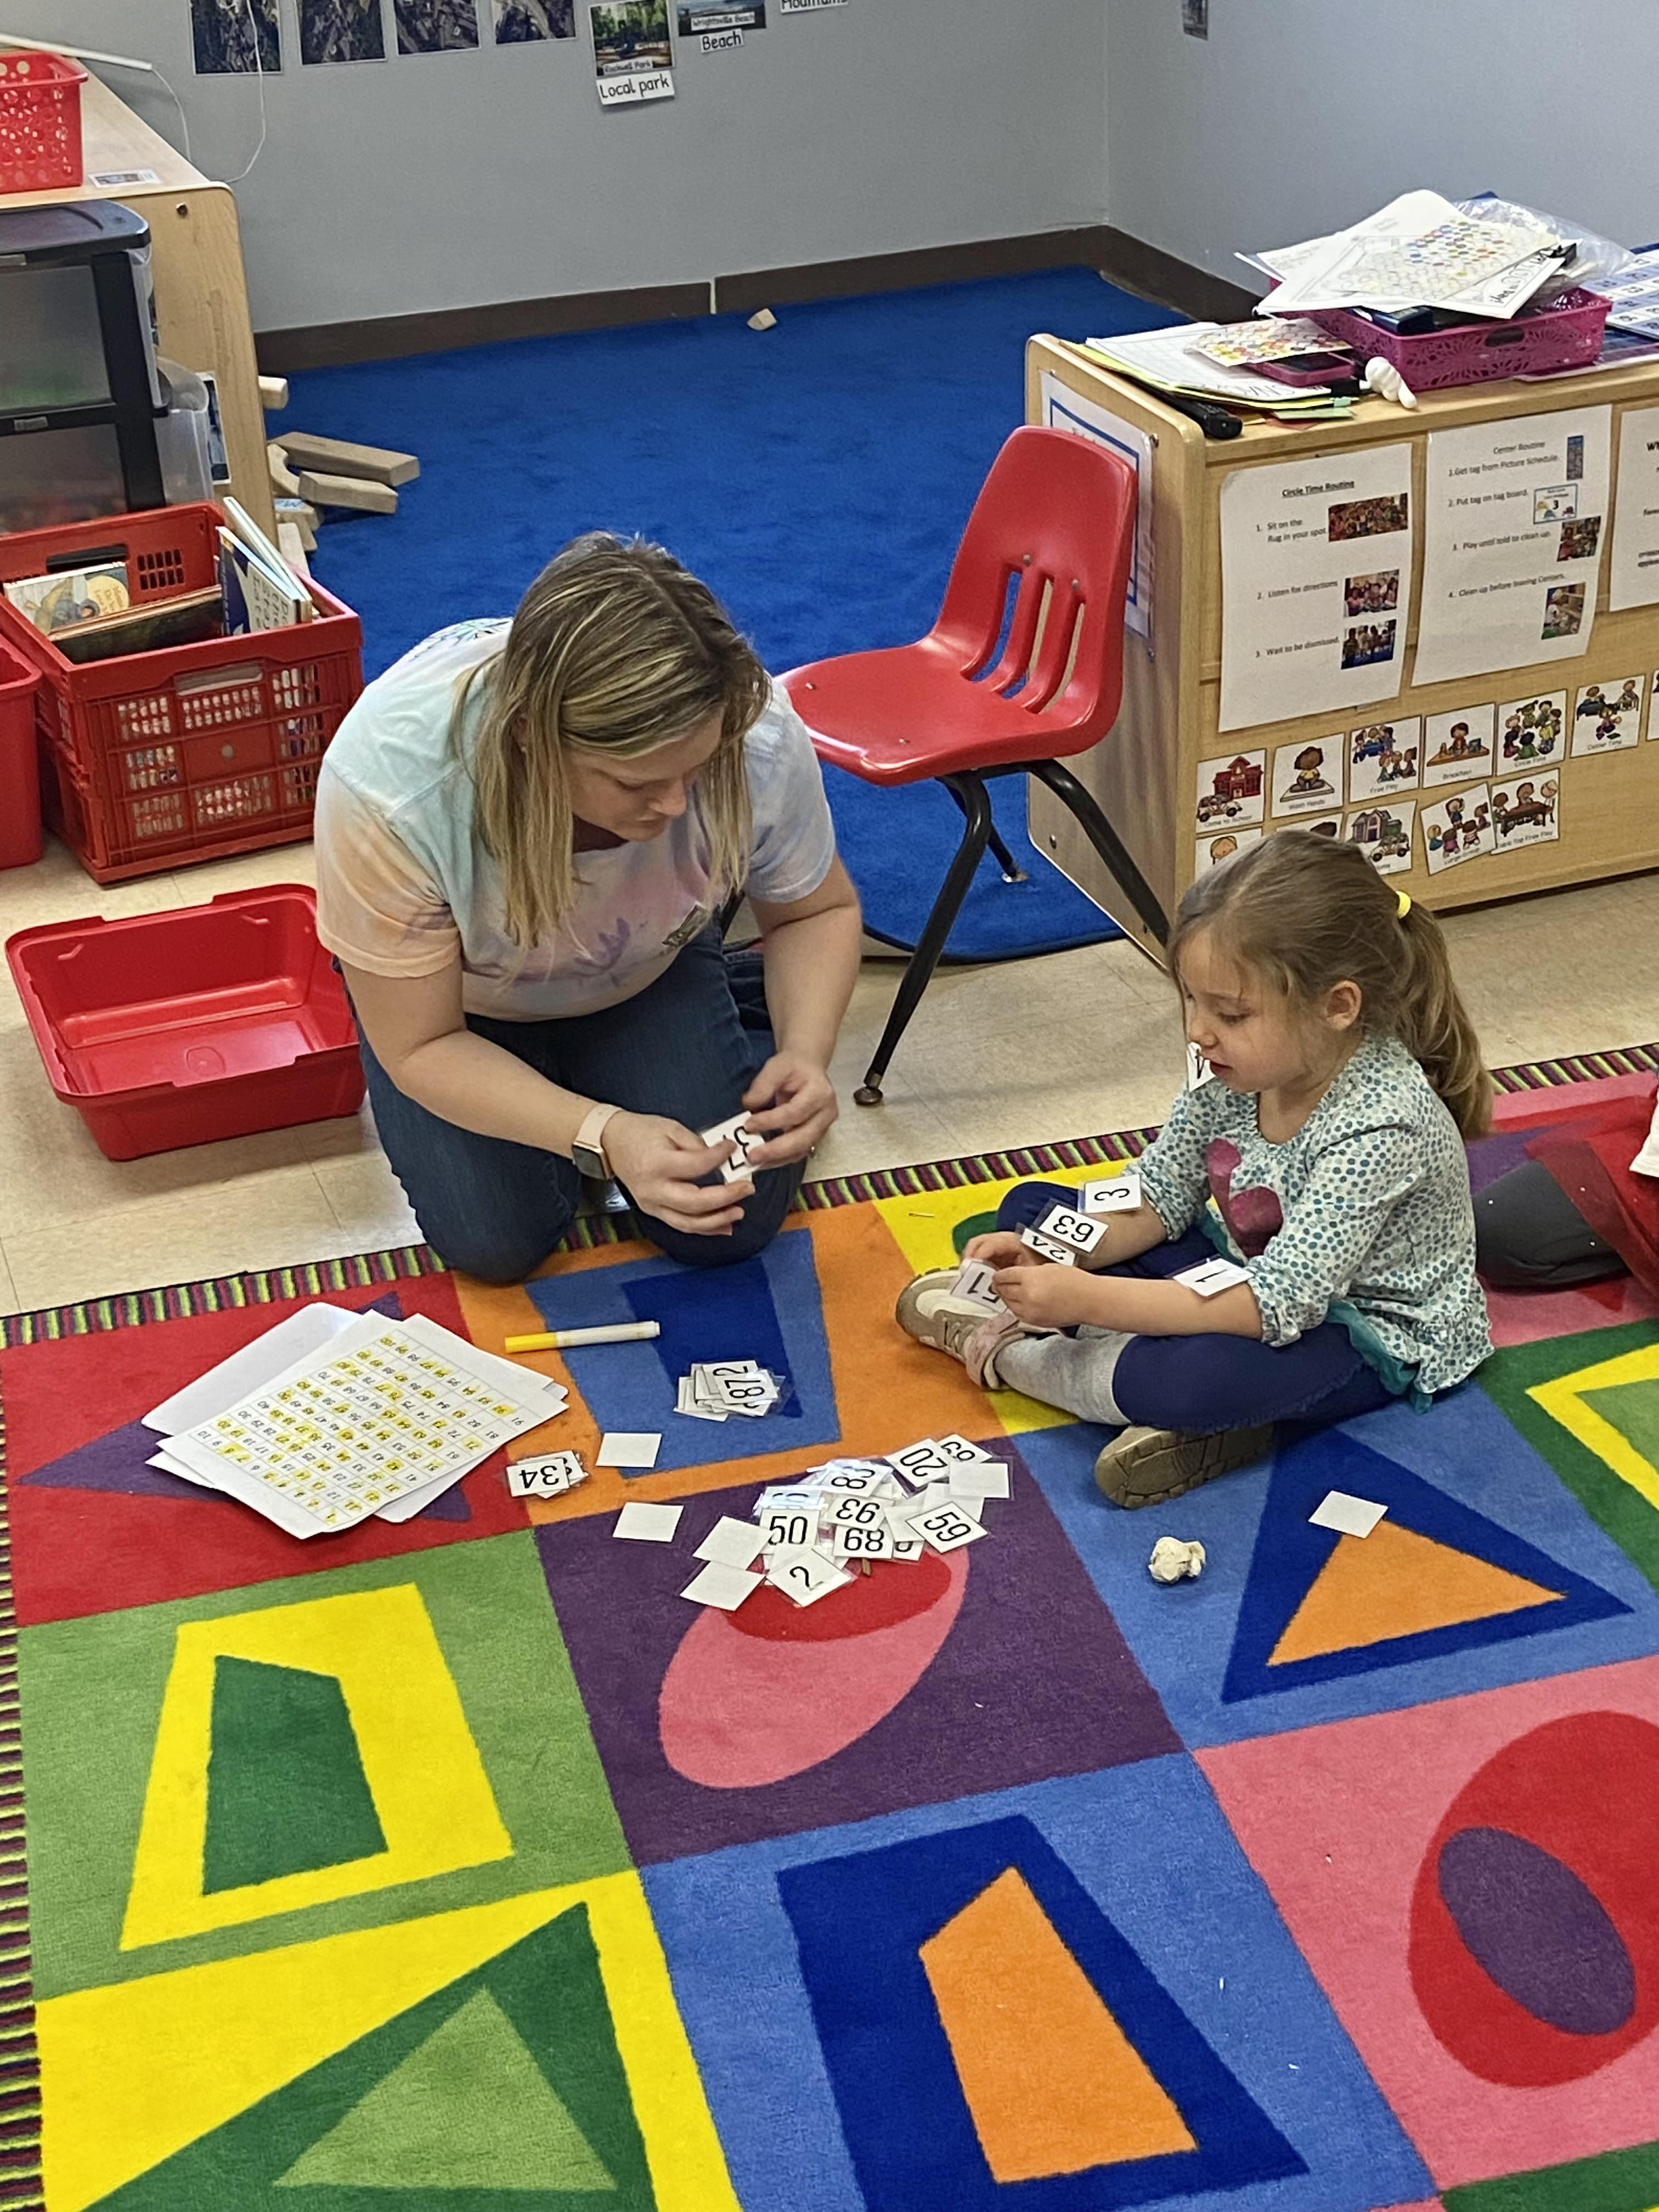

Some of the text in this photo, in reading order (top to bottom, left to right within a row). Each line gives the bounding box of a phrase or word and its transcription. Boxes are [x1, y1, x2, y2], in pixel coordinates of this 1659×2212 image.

[702, 31, 742, 50] Beach
[634, 60, 651, 69] Park
[600, 74, 669, 98] Local park
[1500, 460, 1525, 468] Picture
[1282, 487, 1304, 497] Circle
[1305, 486, 1323, 494] Time
[1493, 493, 1505, 501] tag
[1553, 500, 1559, 510] 3
[1267, 522, 1277, 530] Sit
[1293, 531, 1308, 540] your
[1521, 532, 1539, 541] clean
[1268, 589, 1290, 598] Listen
[1459, 588, 1477, 597] Clean
[1489, 582, 1511, 591] before
[1266, 646, 1284, 656] Wait
[1294, 643, 1303, 651] be
[1370, 785, 1384, 794] Free
[1289, 802, 1305, 810] Wash
[1094, 1187, 1130, 1203] 3
[1053, 1215, 1094, 1243] 63
[1195, 1269, 1227, 1283] 1
[318, 1372, 331, 1380] 70
[362, 1376, 376, 1385] 78
[446, 1378, 461, 1387] 95
[401, 1401, 416, 1410] 75
[238, 1410, 252, 1419] 30
[416, 1411, 431, 1420] 74
[251, 1420, 264, 1428] 29
[511, 1417, 524, 1426] 91
[197, 1431, 212, 1440] 10
[263, 1427, 277, 1436] 28
[321, 1442, 336, 1451] 35
[301, 1453, 317, 1462] 25
[281, 1463, 296, 1471] 15
[899, 1448, 948, 1477] 20
[332, 1473, 347, 1481] 23
[519, 1465, 560, 1489] 34
[326, 1491, 341, 1500] 12
[836, 1498, 881, 1523] 93
[768, 1516, 808, 1546] 50
[923, 1511, 972, 1542] 59
[789, 1566, 825, 1591] 2
